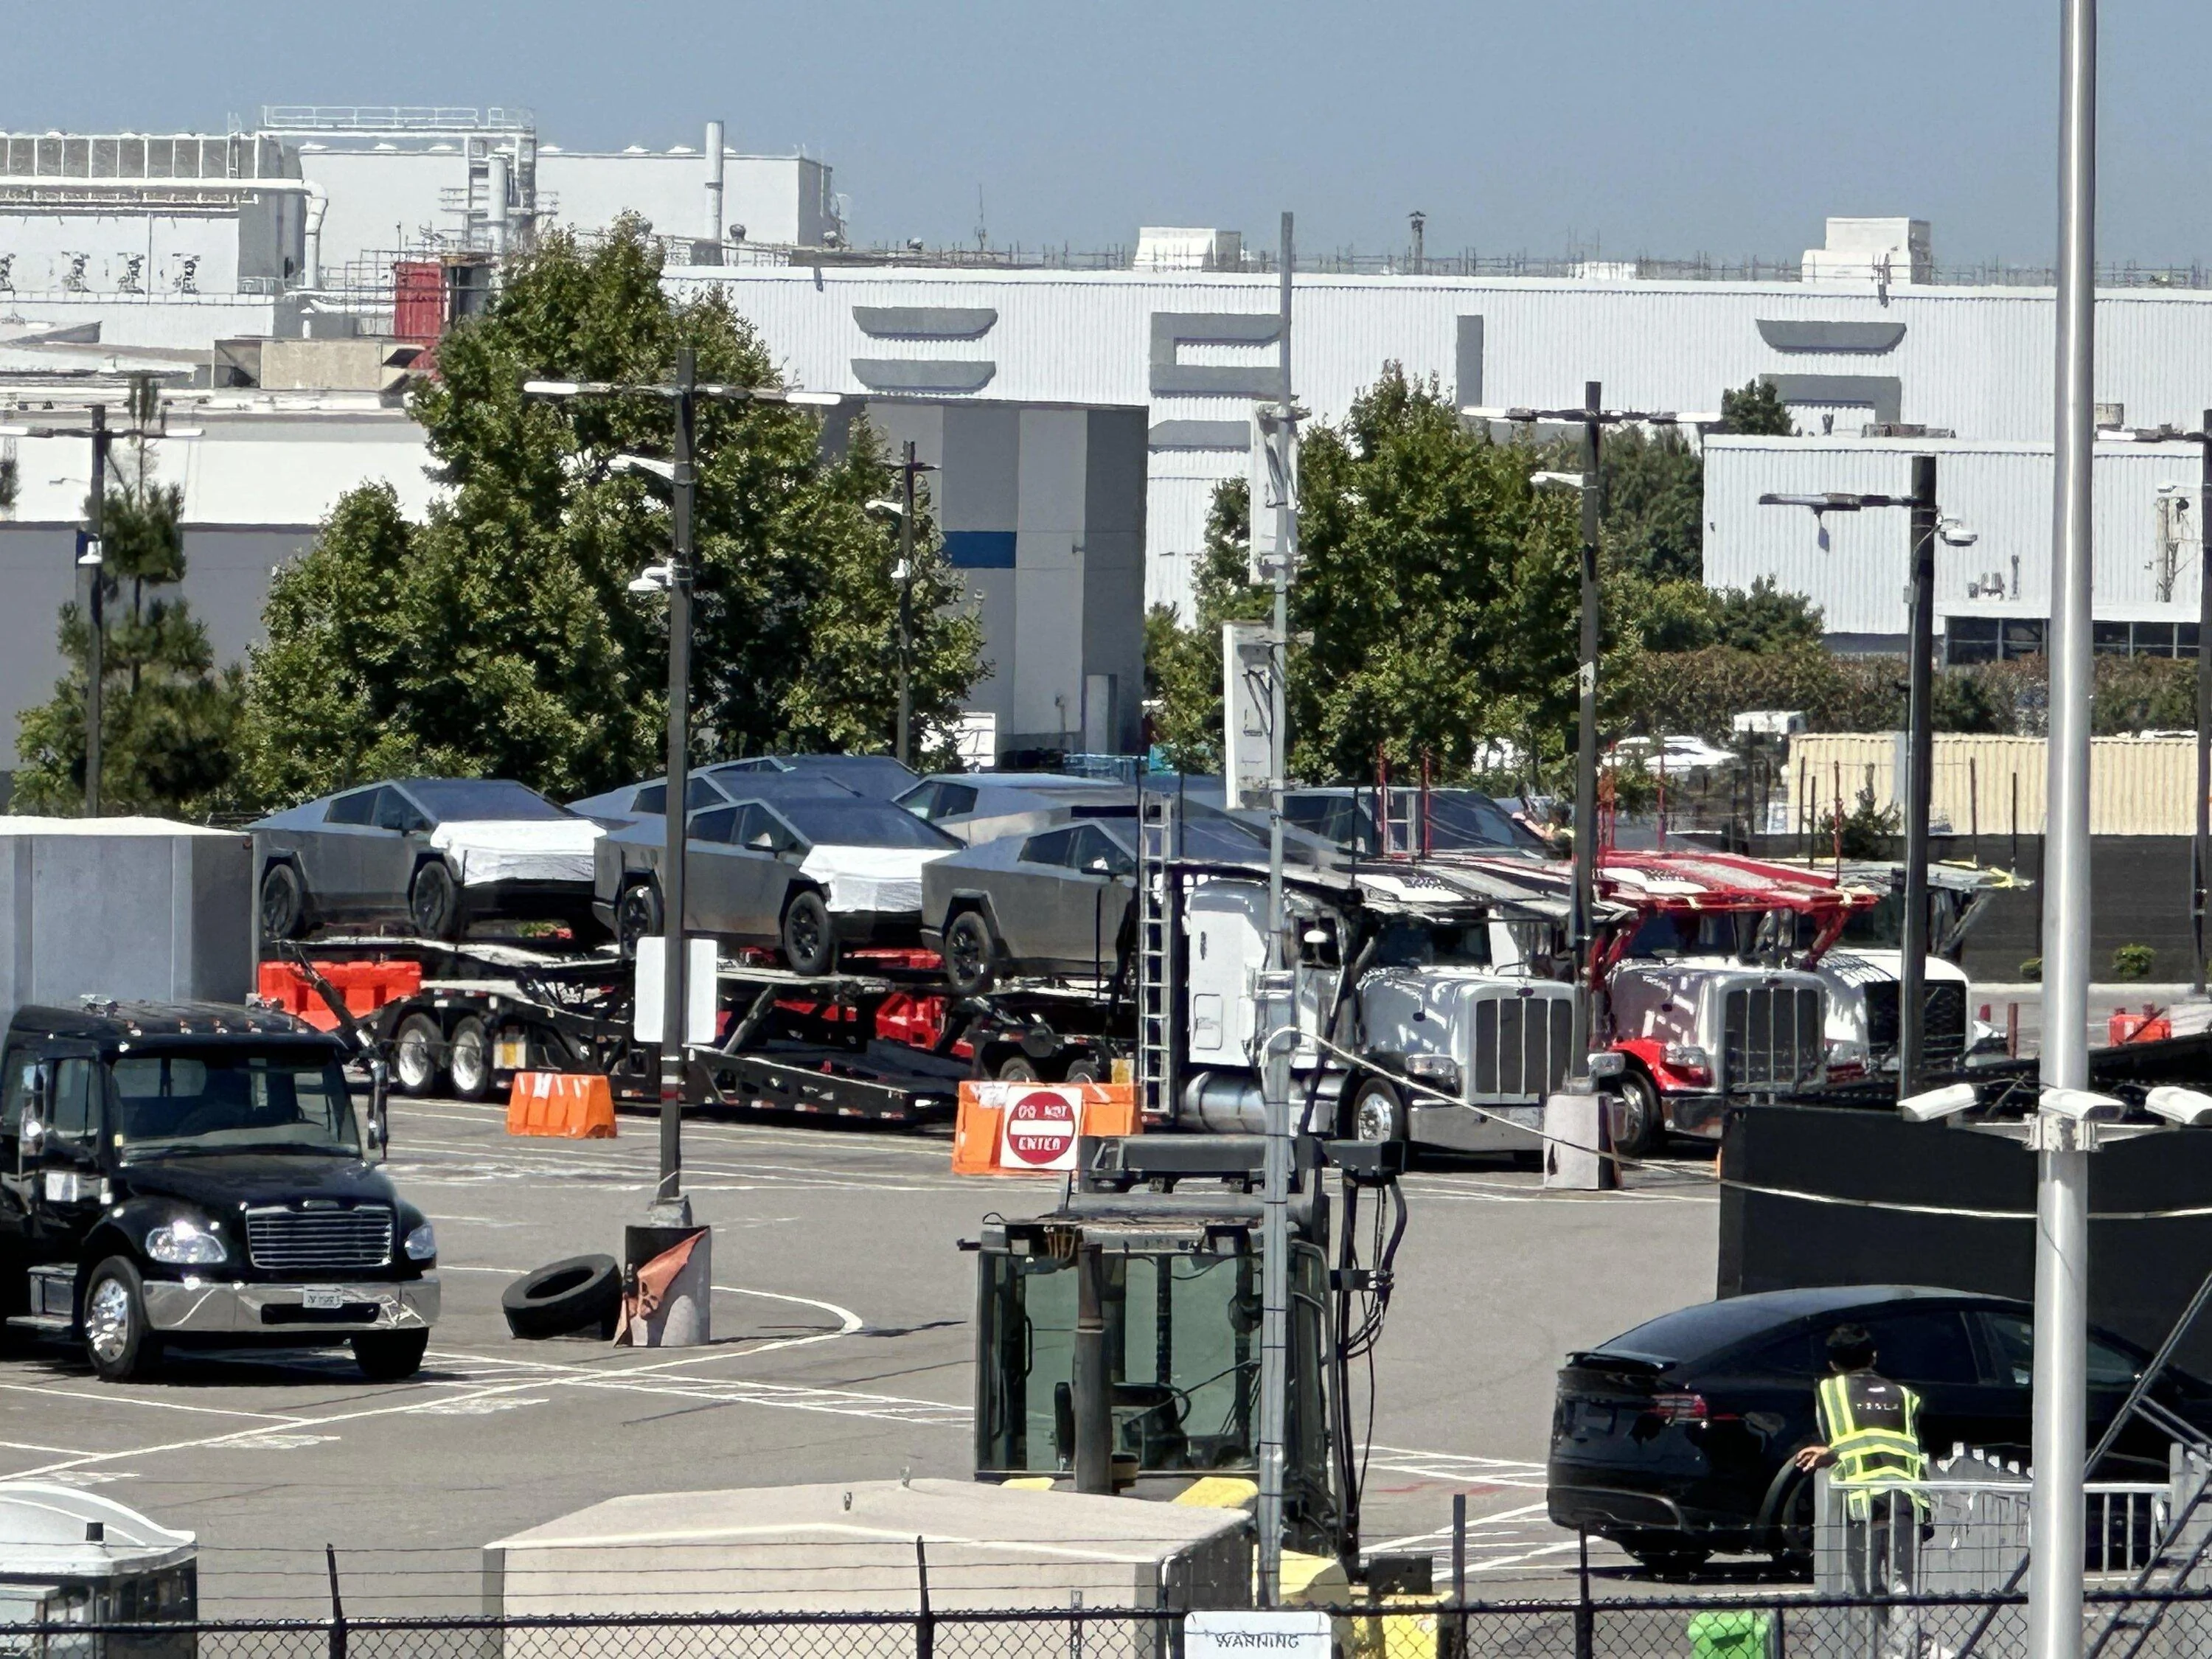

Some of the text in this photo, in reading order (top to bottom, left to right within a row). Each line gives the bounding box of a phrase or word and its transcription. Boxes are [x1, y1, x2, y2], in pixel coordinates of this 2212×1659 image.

[1018, 1105, 1068, 1119] DO NOT
[1018, 1137, 1061, 1151] ENTER
[1856, 1402, 1899, 1411] TESLA
[1215, 1633, 1300, 1649] WARNING
